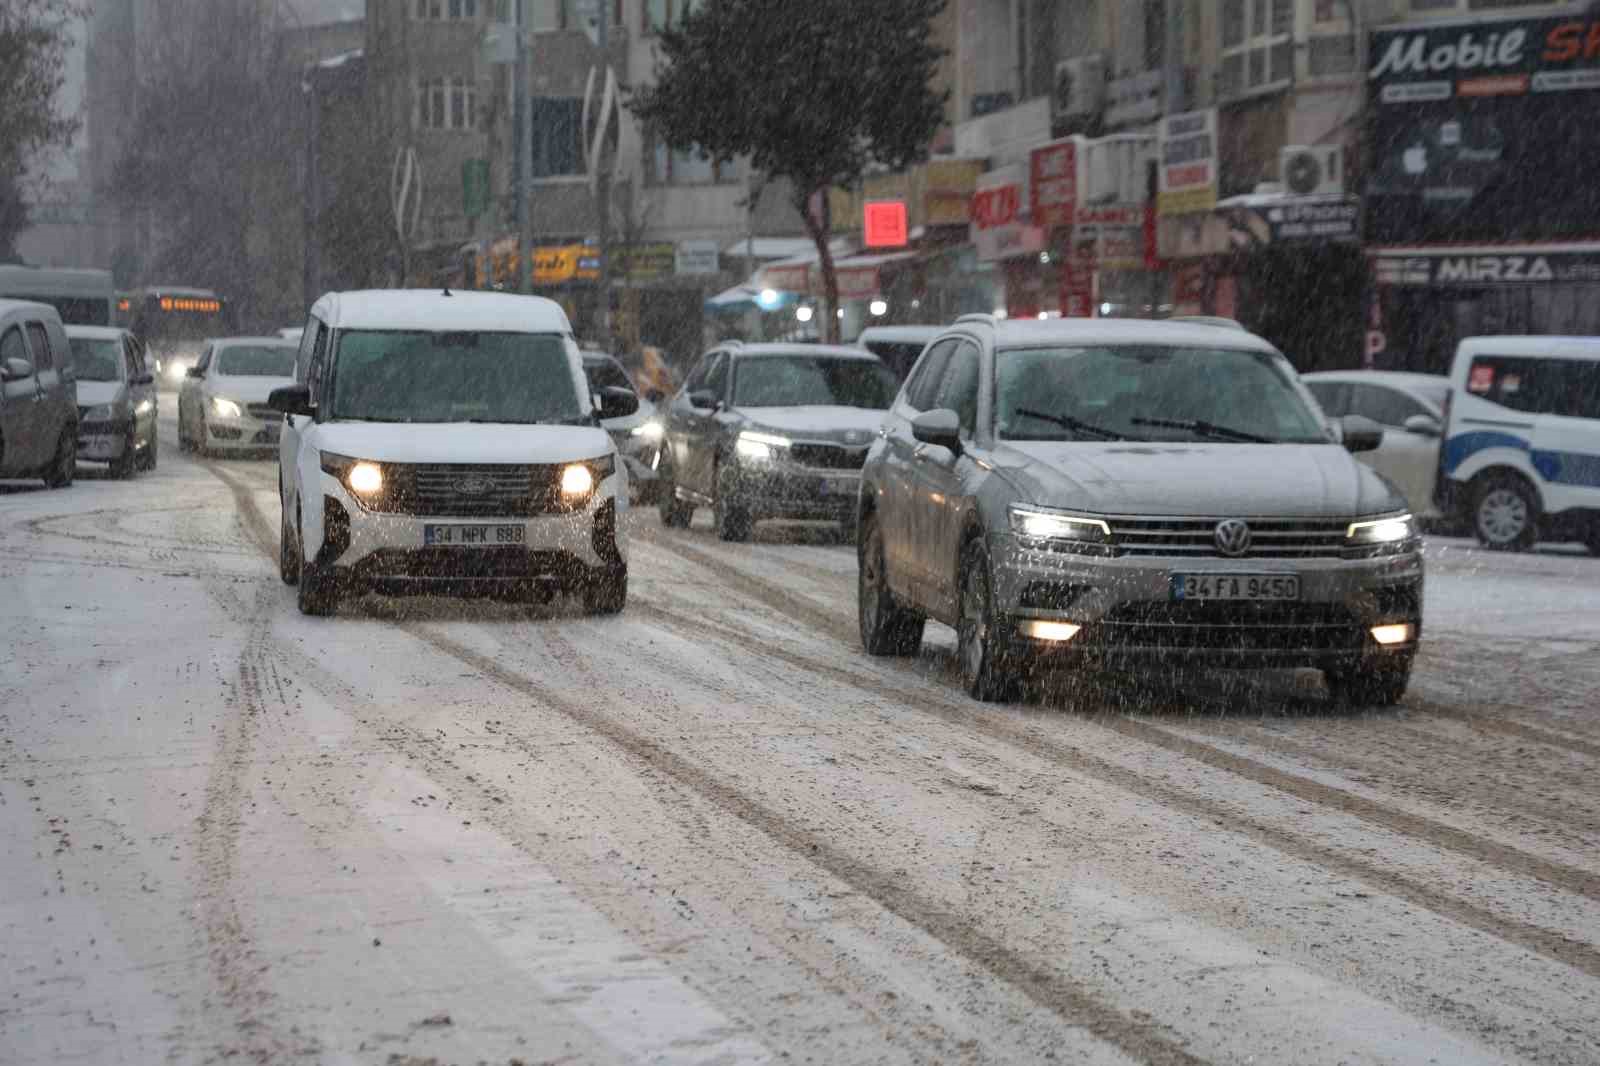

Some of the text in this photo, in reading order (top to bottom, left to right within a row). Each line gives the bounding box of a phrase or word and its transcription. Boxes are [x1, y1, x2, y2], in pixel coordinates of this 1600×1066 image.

[1370, 27, 1527, 78] Mobil
[435, 527, 451, 542] 34
[462, 527, 487, 542] MPK
[1186, 578, 1296, 597] 34 FA 9450
